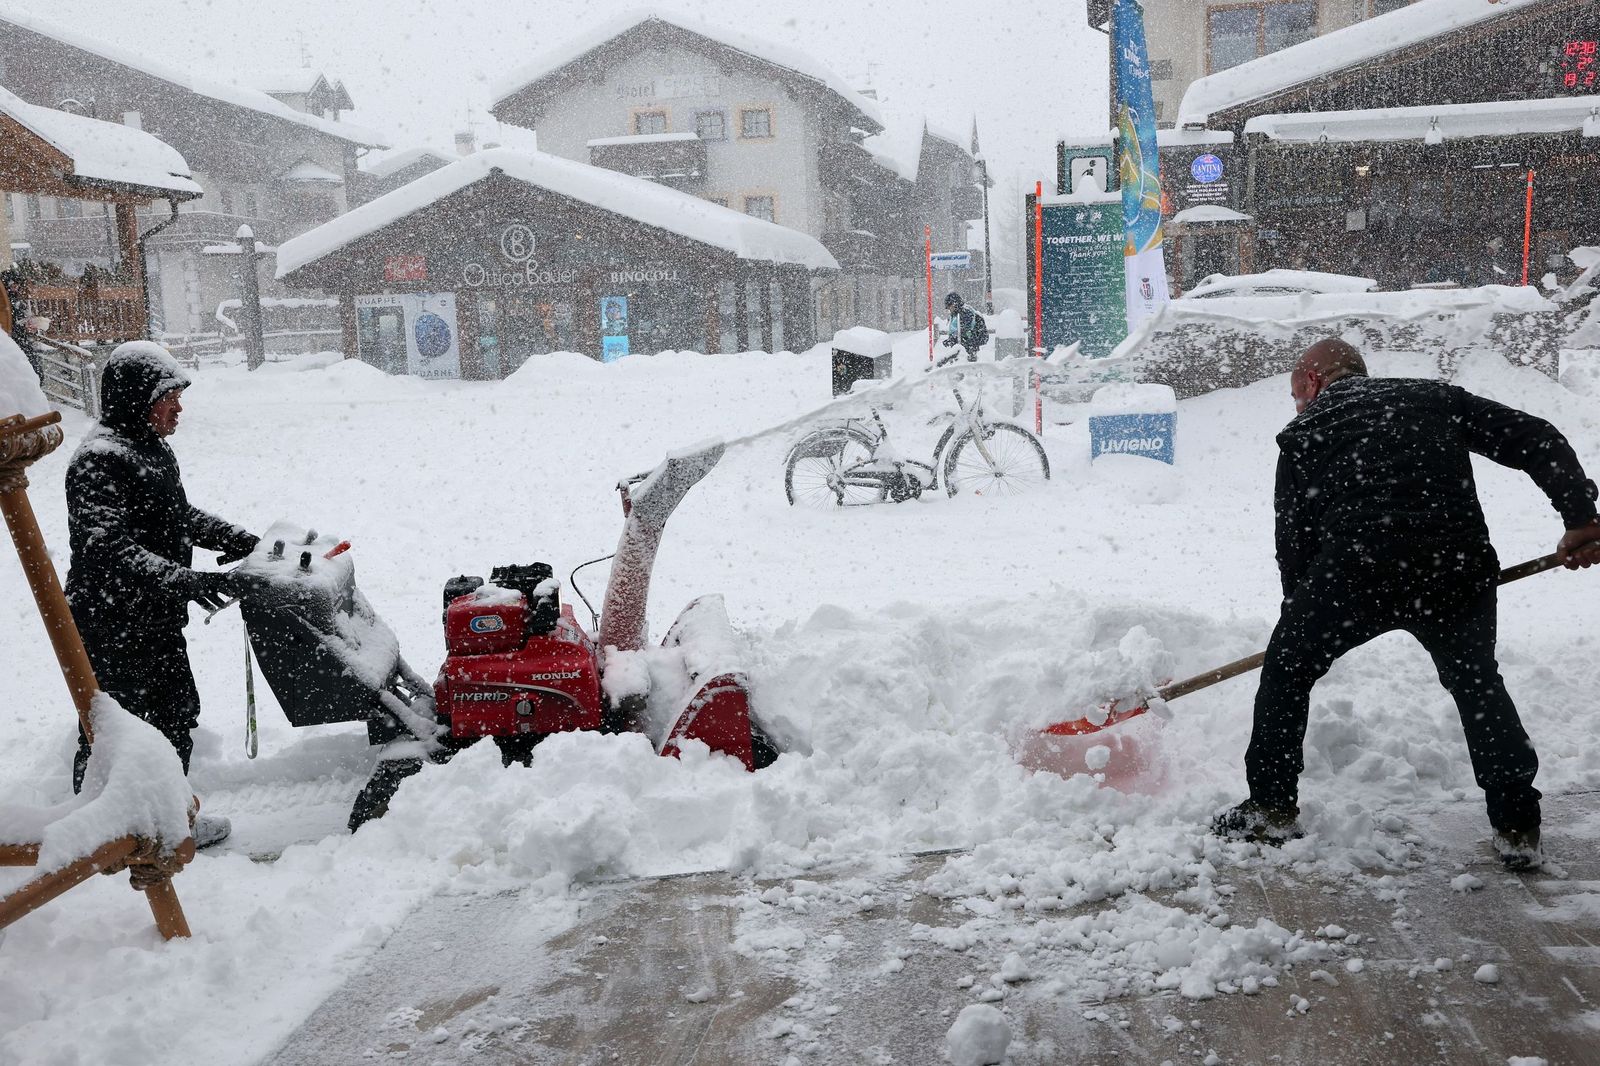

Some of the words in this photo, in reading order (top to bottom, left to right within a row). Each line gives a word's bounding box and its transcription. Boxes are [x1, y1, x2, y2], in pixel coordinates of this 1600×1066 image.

[1192, 163, 1222, 174] CANTINA
[1047, 236, 1095, 245] TOGETHER,
[1097, 234, 1112, 242] WE
[1113, 232, 1124, 241] WI
[464, 263, 524, 287] Ottica
[526, 259, 577, 285] Bauer
[610, 270, 679, 283] BINOCOLI
[358, 296, 401, 305] VUARNE
[1101, 437, 1164, 453] LIVIGNO
[531, 669, 582, 681] HONDA
[453, 691, 509, 701] HYBRID
